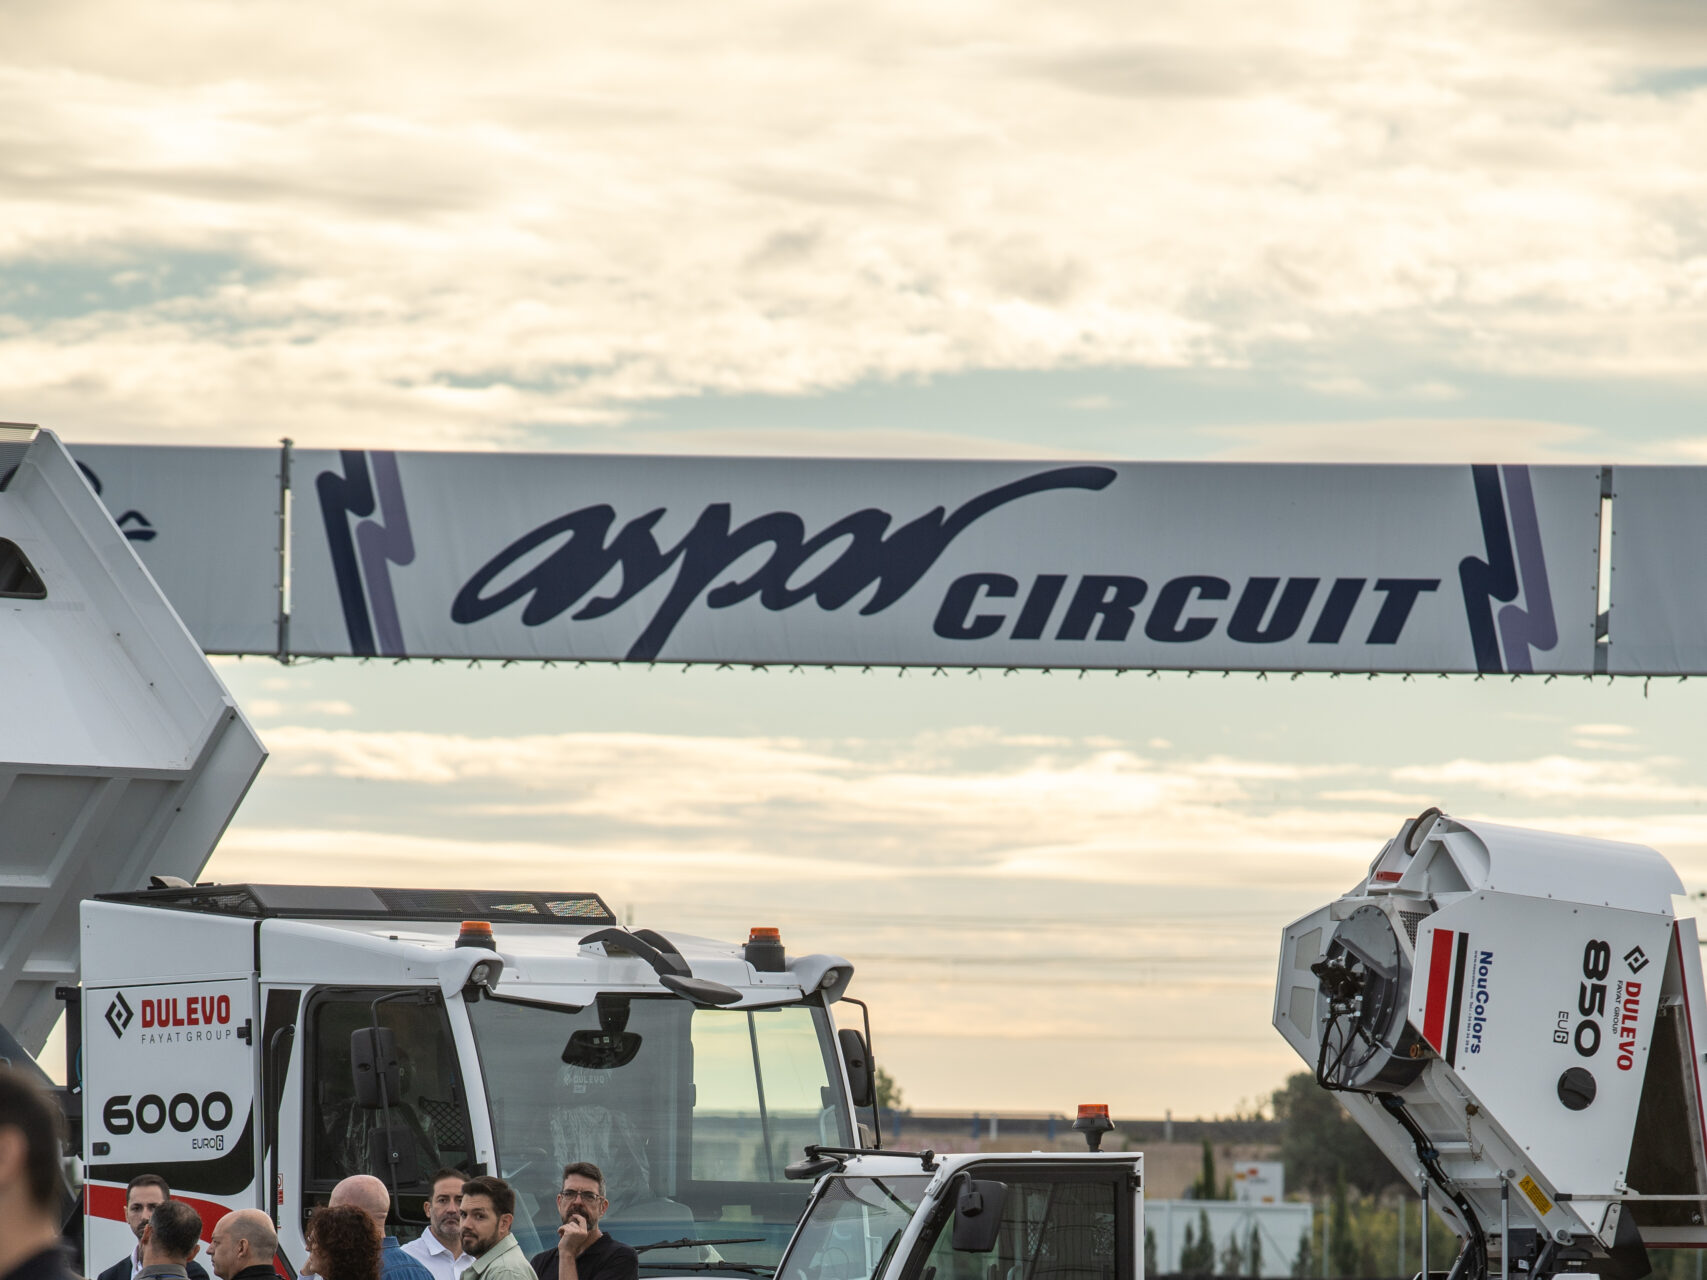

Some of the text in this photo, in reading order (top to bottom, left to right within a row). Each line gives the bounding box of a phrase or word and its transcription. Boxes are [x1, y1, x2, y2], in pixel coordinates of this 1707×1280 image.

[451, 466, 1441, 662] aspar CIRCUIT
[141, 994, 231, 1029] DULEVO
[1470, 950, 1494, 1054] NouColors
[1574, 939, 1611, 1058] 850
[1612, 980, 1623, 1035] FAYAT GROUP
[1616, 980, 1642, 1071] DULEVO
[141, 1029, 232, 1045] FAYAT GROUP
[102, 1091, 234, 1136] 6000
